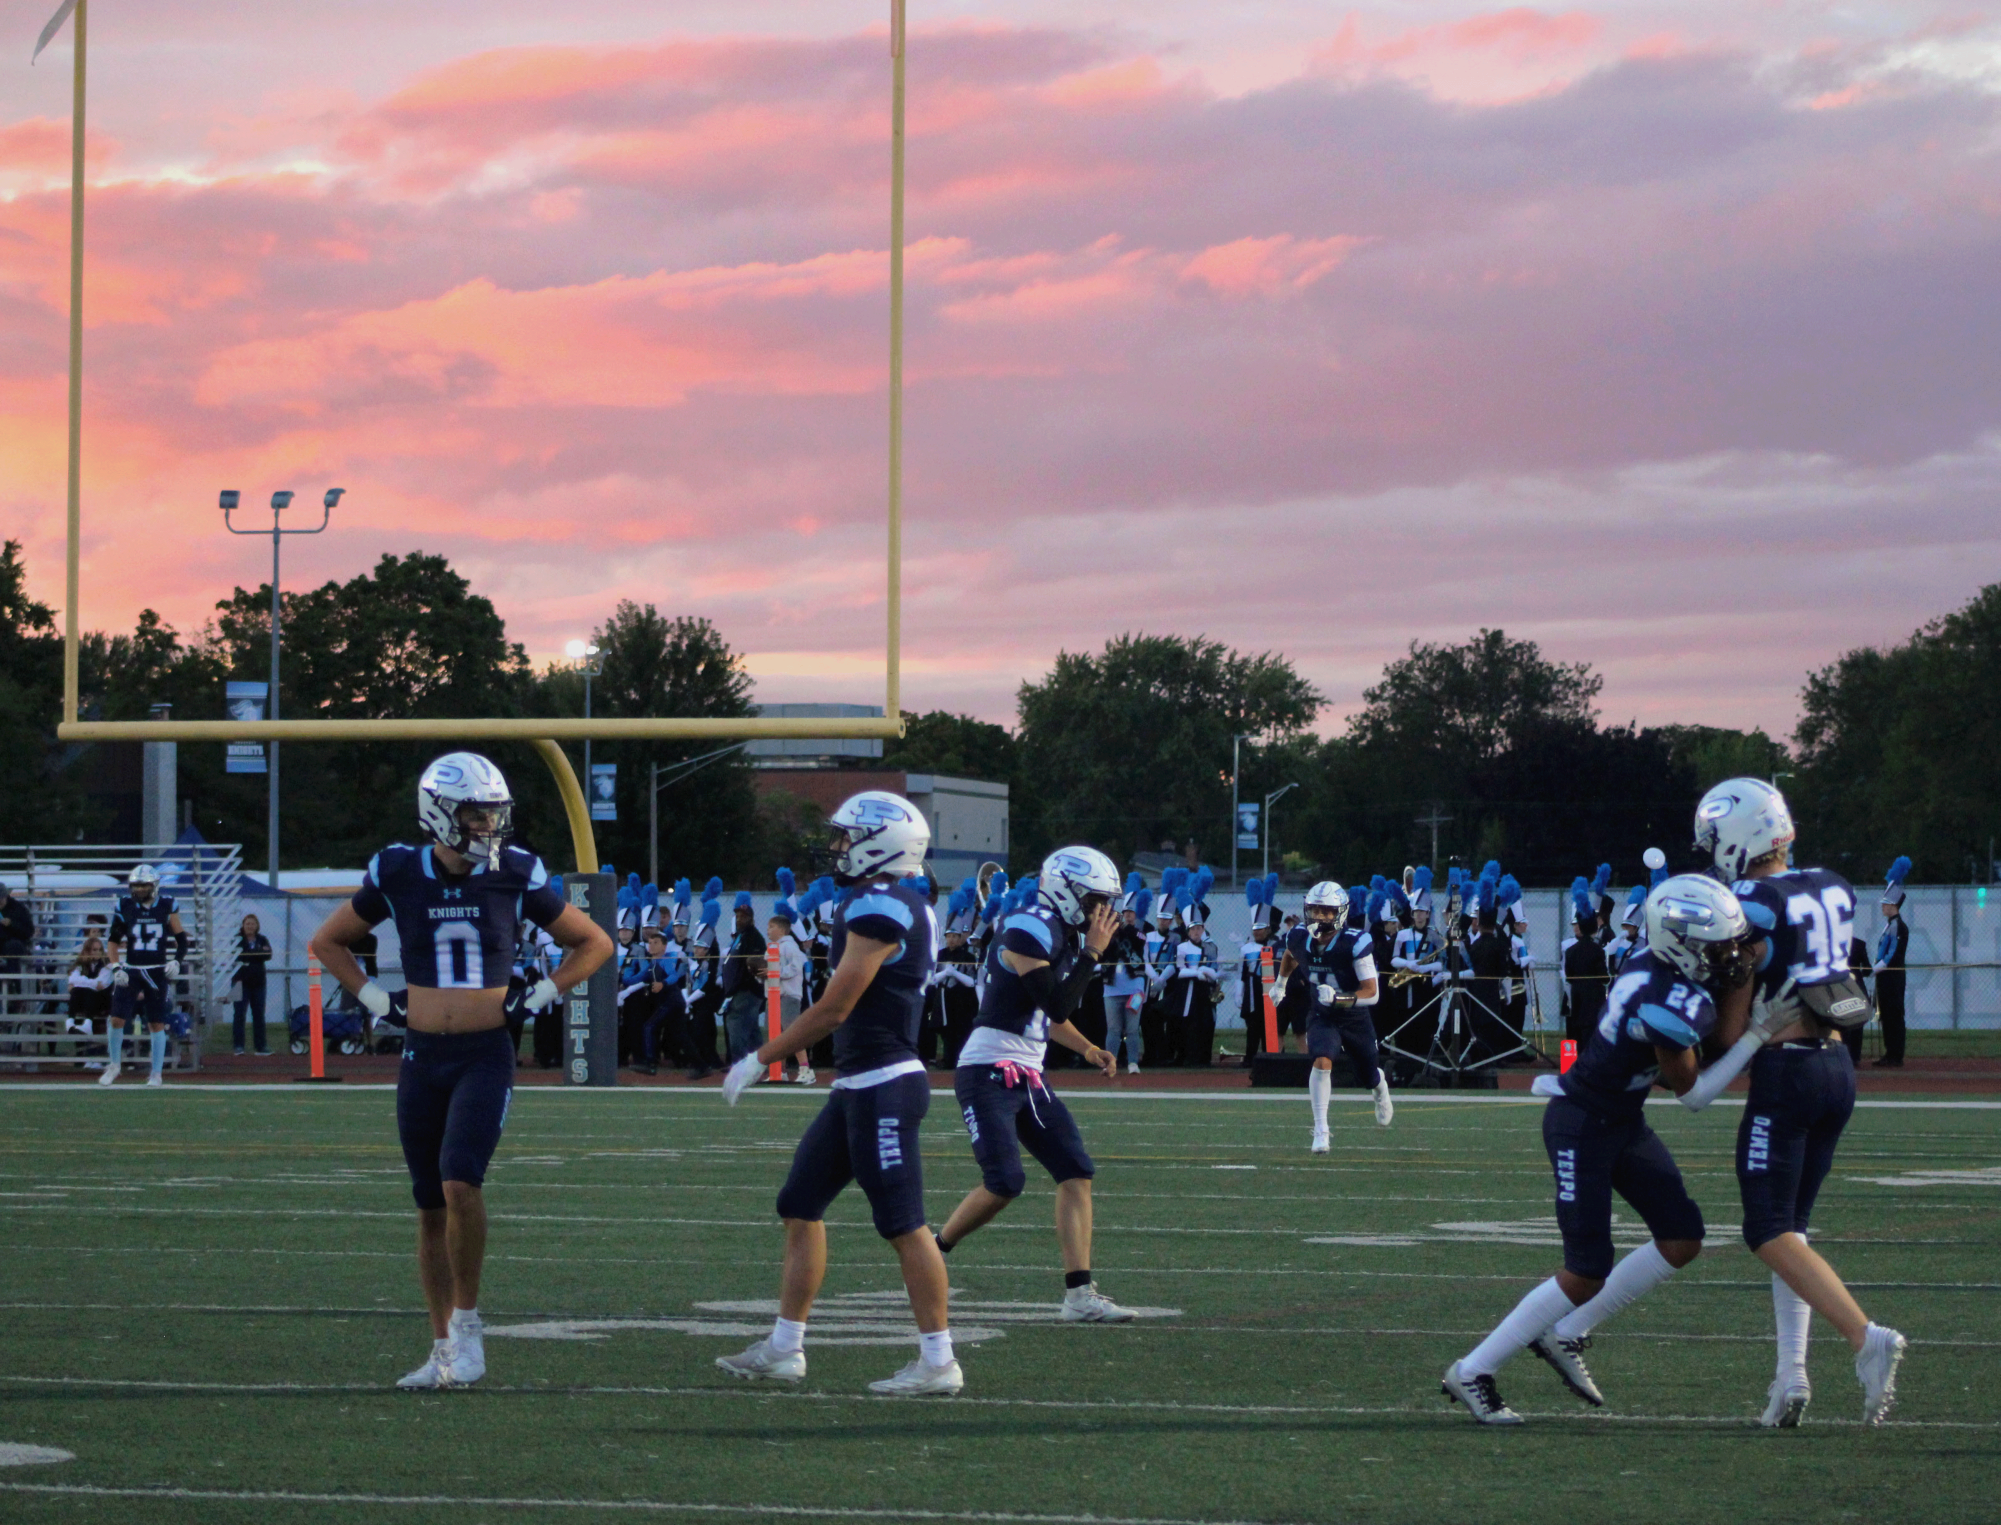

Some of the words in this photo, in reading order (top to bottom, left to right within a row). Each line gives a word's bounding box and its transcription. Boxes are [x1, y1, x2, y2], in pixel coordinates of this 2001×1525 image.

[855, 799, 906, 826] P
[1051, 854, 1092, 877] P
[428, 906, 480, 919] KNIGHTS
[1661, 896, 1713, 933] P
[1786, 885, 1854, 984] 36
[132, 923, 164, 952] 17
[434, 920, 484, 989] 0
[570, 883, 590, 1083] KGHTS
[1664, 982, 1704, 1021] 24
[878, 1118, 904, 1171] TEMPO
[1747, 1115, 1772, 1171] TEMPO
[1557, 1148, 1576, 1202] TEMPO
